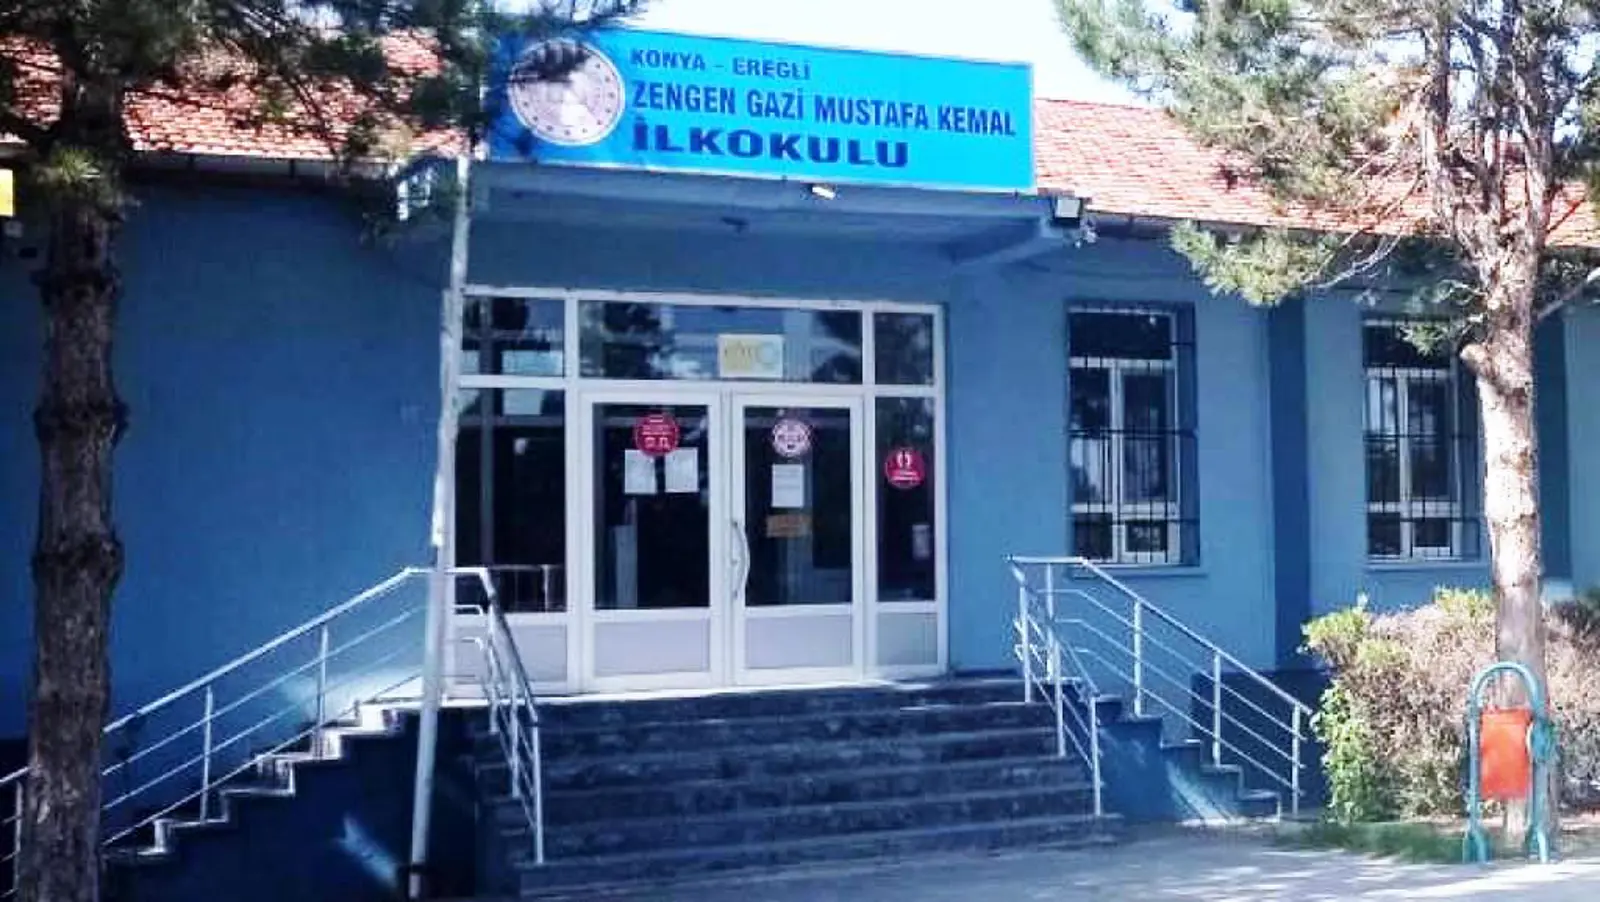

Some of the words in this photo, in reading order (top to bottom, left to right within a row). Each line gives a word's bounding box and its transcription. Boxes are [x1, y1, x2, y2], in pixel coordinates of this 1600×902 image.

[630, 49, 706, 72] KONYA
[632, 80, 736, 114] ZENGEN
[747, 88, 804, 121] GAZİ
[814, 94, 929, 130] MUSTAFA
[937, 104, 1016, 136] KEMAL
[633, 113, 908, 167] İLKOKULU
